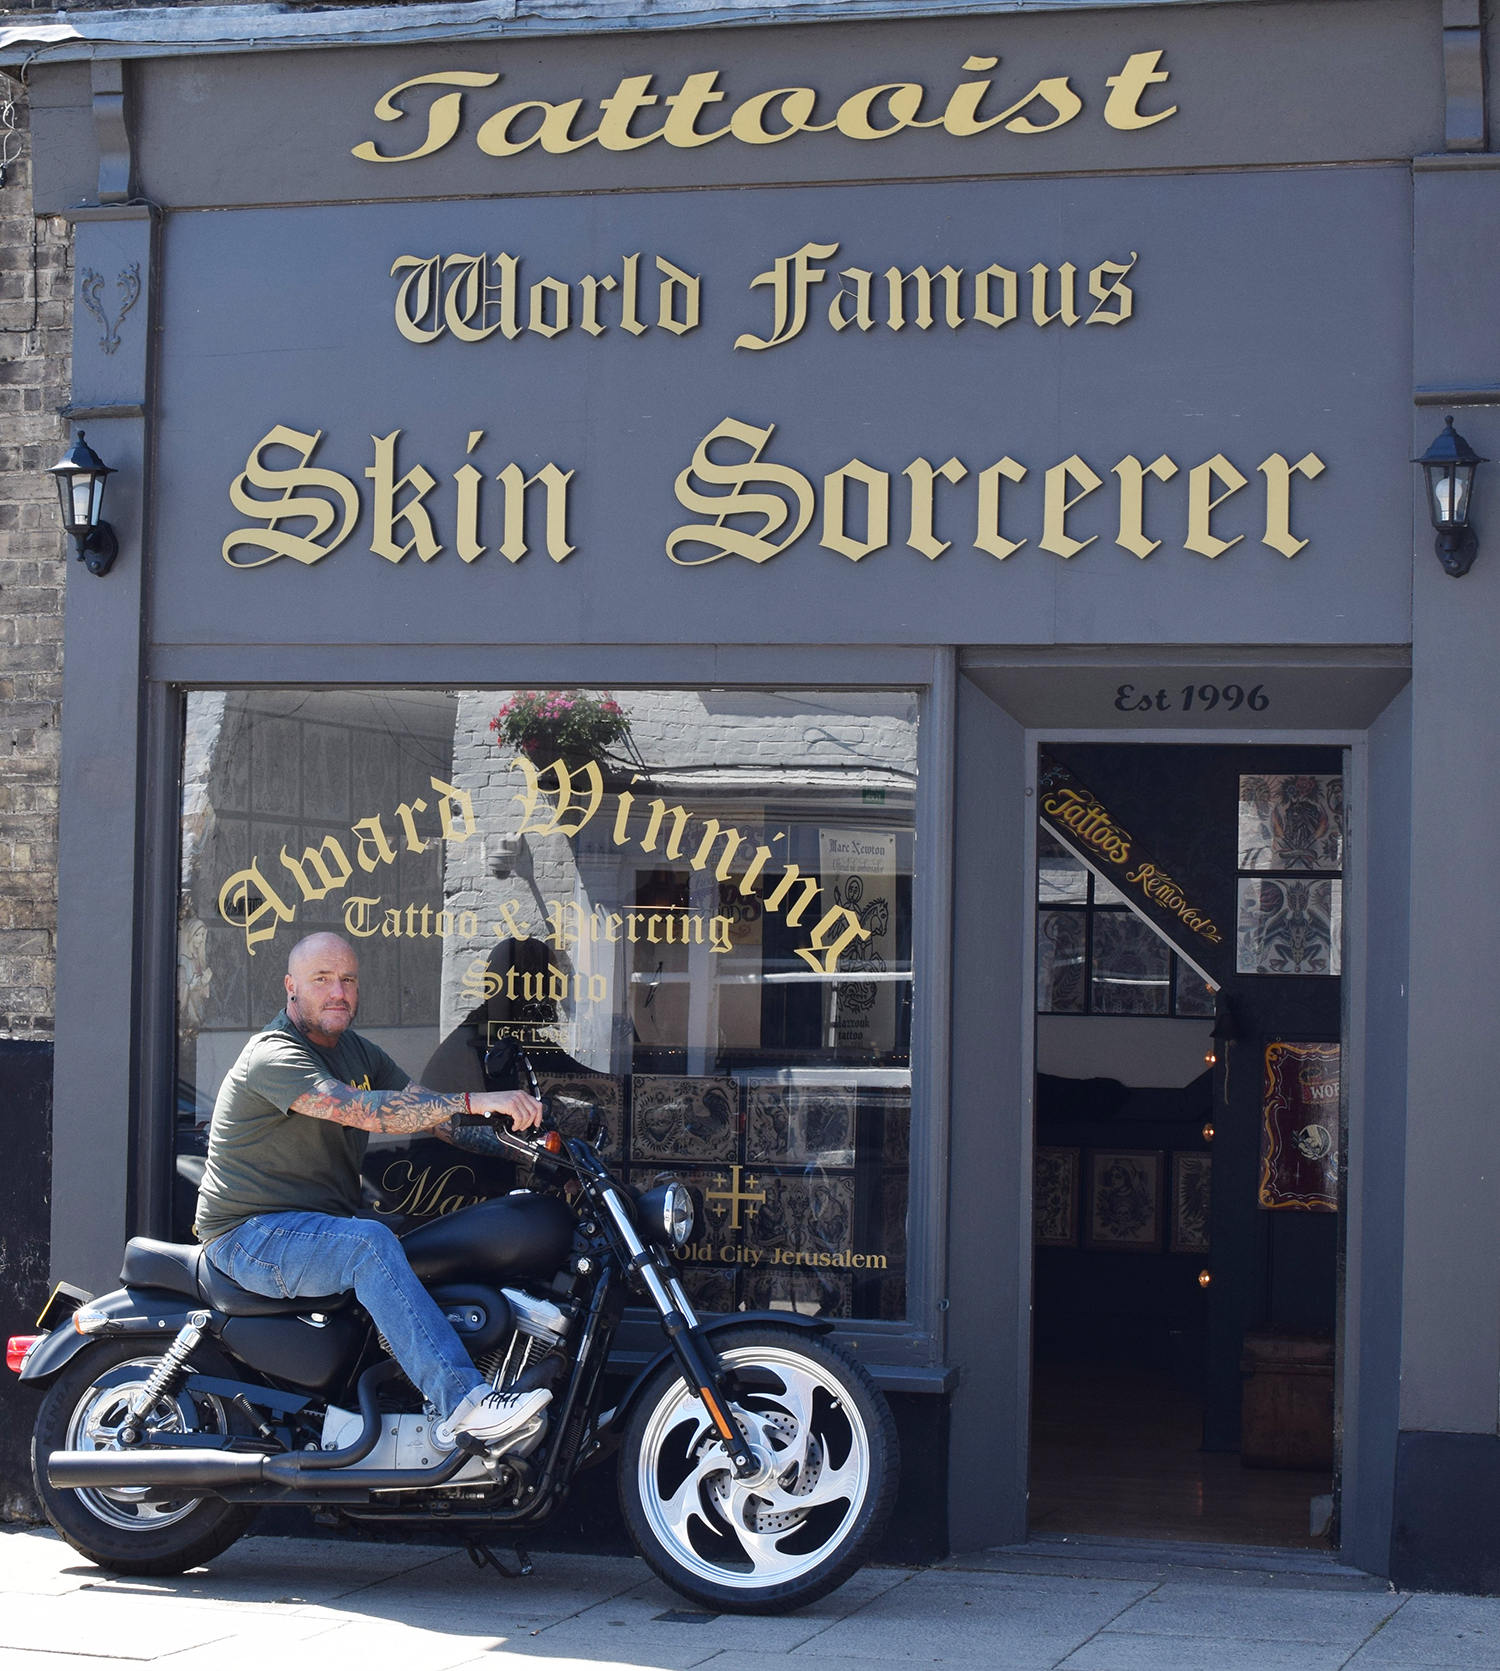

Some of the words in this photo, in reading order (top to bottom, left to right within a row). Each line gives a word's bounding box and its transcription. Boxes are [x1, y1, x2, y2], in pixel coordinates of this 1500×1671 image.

[351, 49, 1178, 163] Tattooist
[390, 251, 701, 344] World
[735, 241, 1138, 351] Famous
[221, 423, 577, 569] Skin
[665, 415, 1327, 568] Sorcerer
[1114, 684, 1171, 712] Est
[1180, 684, 1270, 712] 1996
[218, 776, 476, 956] Award
[510, 758, 871, 974] Winning
[1043, 787, 1131, 864] Tattoos
[1125, 862, 1213, 933] Removed
[341, 896, 479, 939] Tattoo
[492, 899, 530, 942] &
[543, 900, 735, 954] Piercing
[460, 959, 608, 1002] Studio
[496, 1025, 526, 1043] Est
[673, 1243, 712, 1262] Old
[719, 1245, 763, 1268] City
[769, 1247, 888, 1270] Jerusalem
